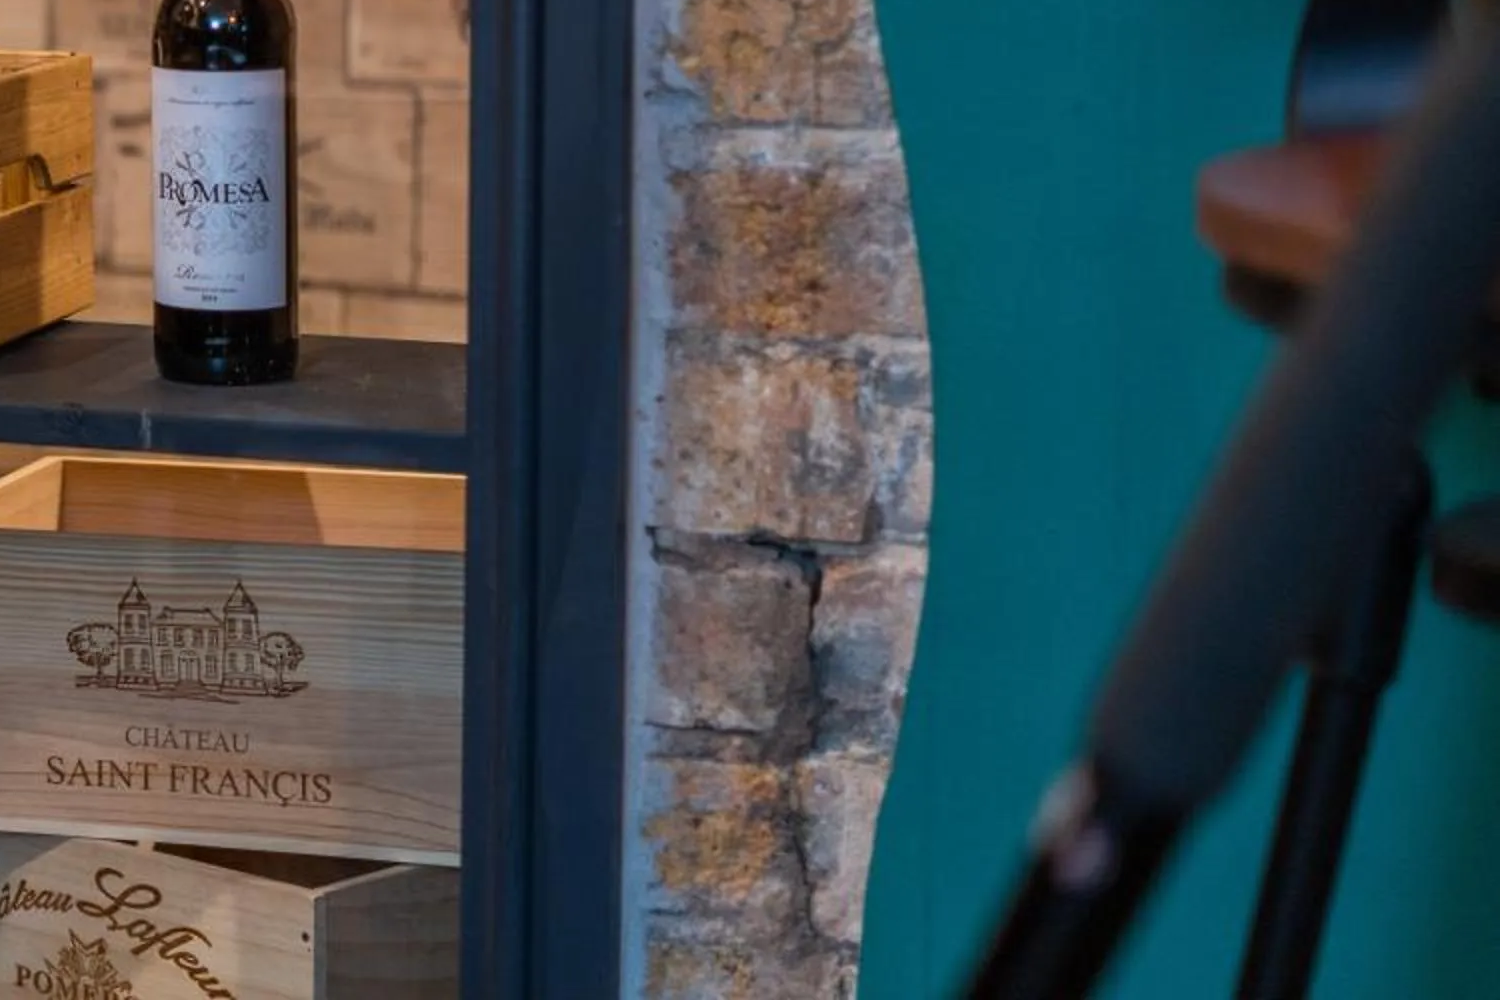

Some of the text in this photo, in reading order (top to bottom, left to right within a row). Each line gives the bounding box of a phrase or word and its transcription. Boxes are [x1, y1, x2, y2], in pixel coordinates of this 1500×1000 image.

[159, 171, 270, 206] PROMESA
[125, 723, 251, 754] CHÂTEAU
[46, 755, 333, 807] SAINT FRANÇIS
